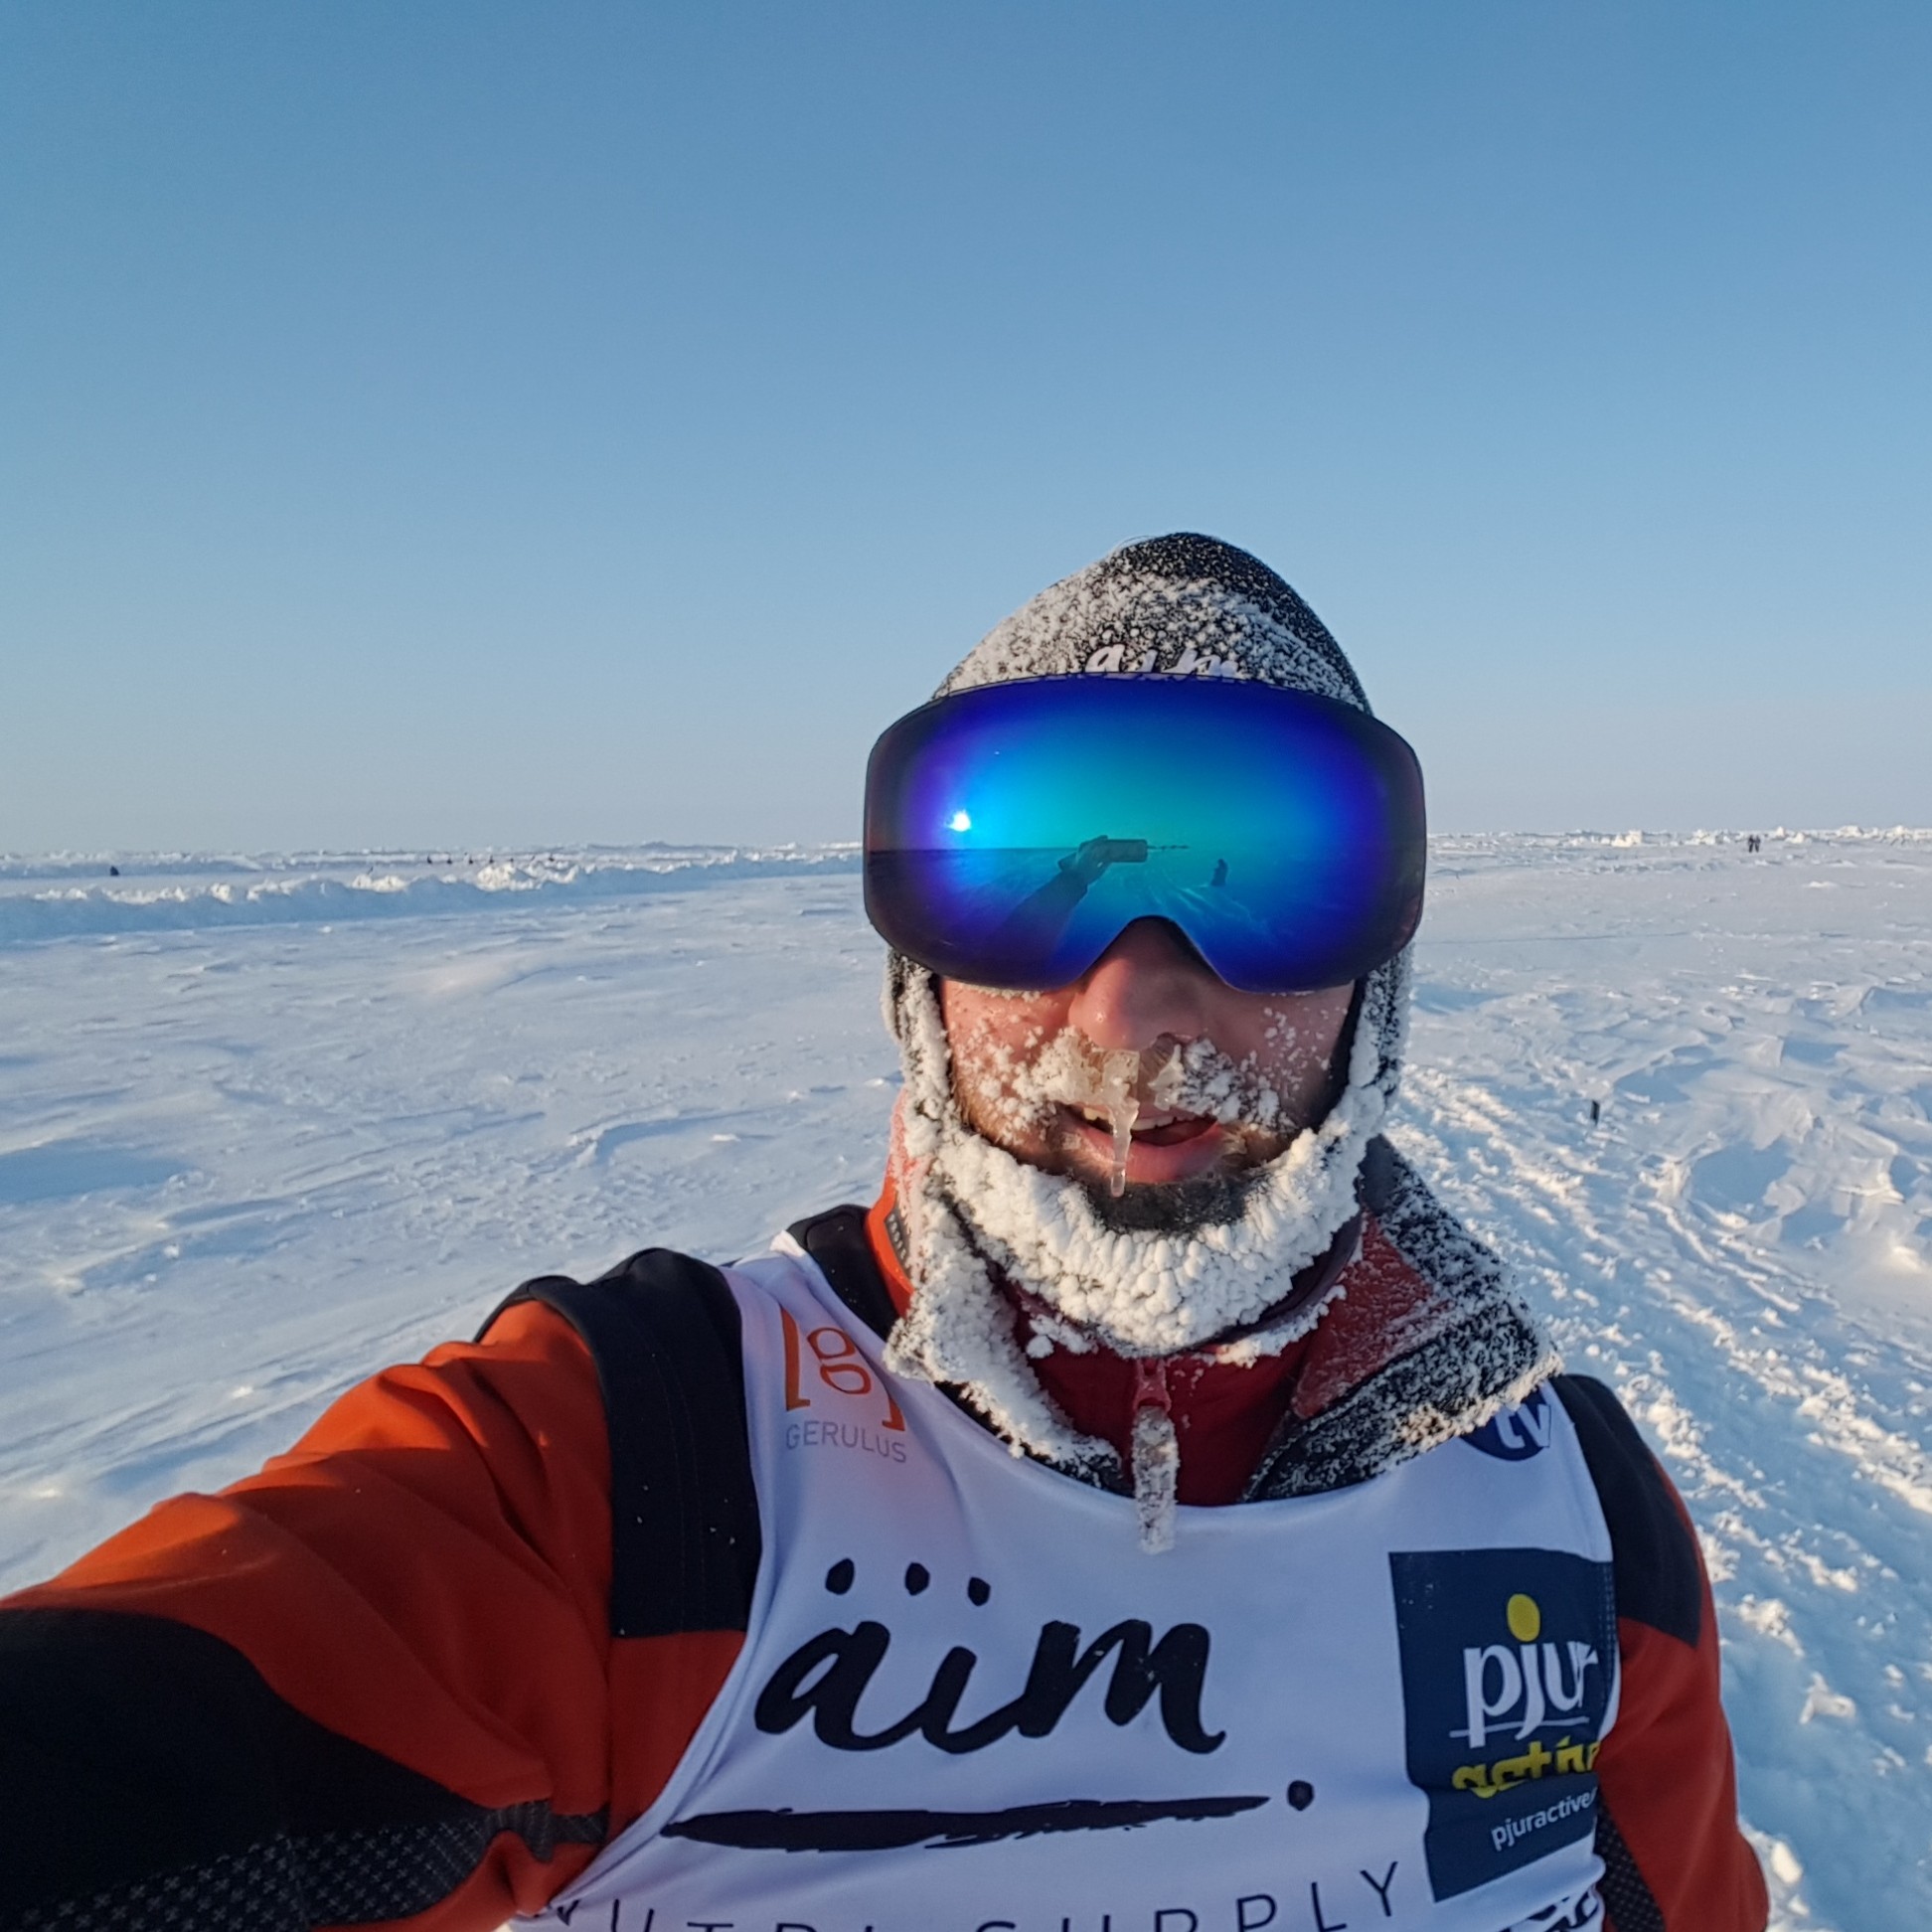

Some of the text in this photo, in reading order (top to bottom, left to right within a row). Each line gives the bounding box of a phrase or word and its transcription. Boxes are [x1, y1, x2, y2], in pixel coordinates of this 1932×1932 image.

[786, 1420, 906, 1463] GERULUS
[1463, 1593, 1599, 1748] pjur
[1491, 1791, 1592, 1852] pjuractive
